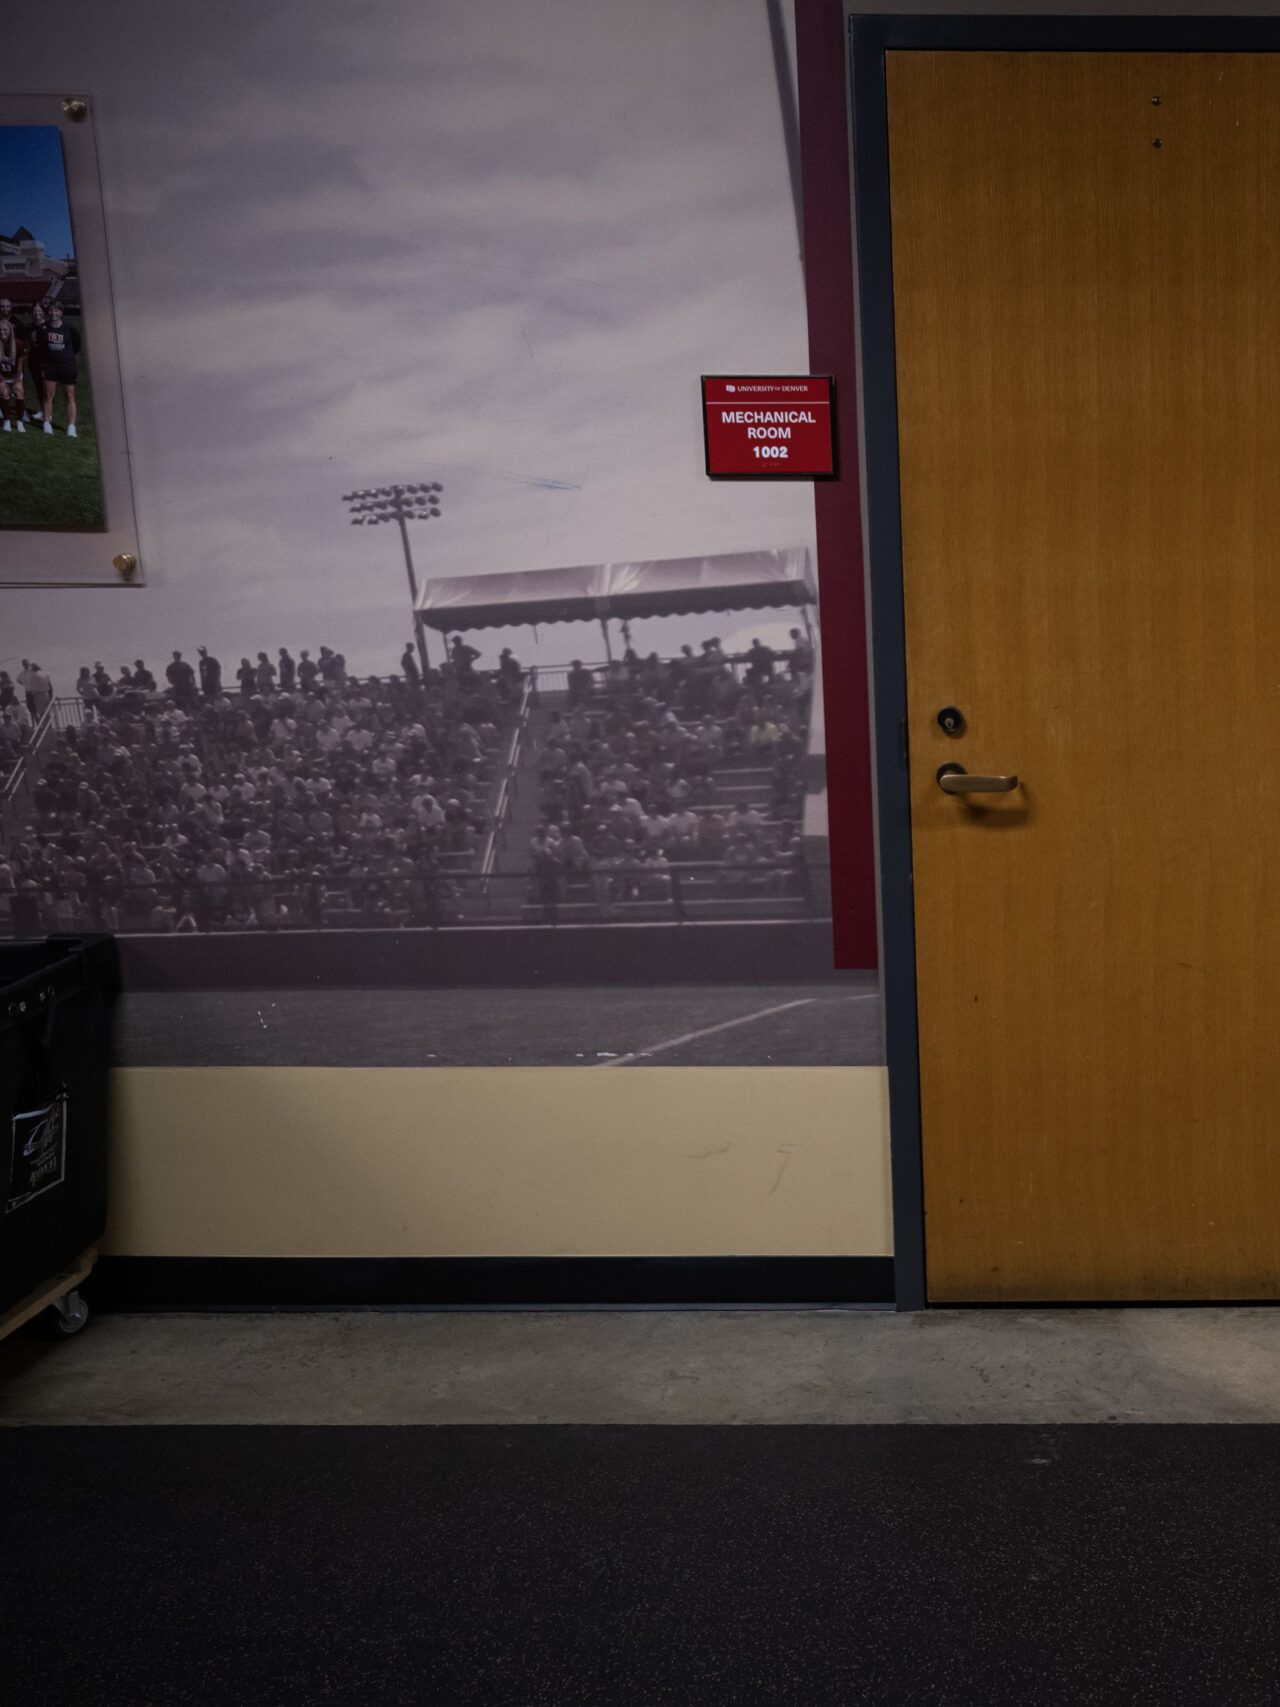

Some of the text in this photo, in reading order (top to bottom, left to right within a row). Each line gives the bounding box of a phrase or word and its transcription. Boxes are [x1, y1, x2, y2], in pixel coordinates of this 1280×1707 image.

[737, 384, 774, 392] UNIVERSITY
[781, 384, 808, 392] DENVER
[721, 411, 816, 424] MECHANICAL
[747, 427, 792, 439] ROOM
[753, 446, 788, 458] 1002
